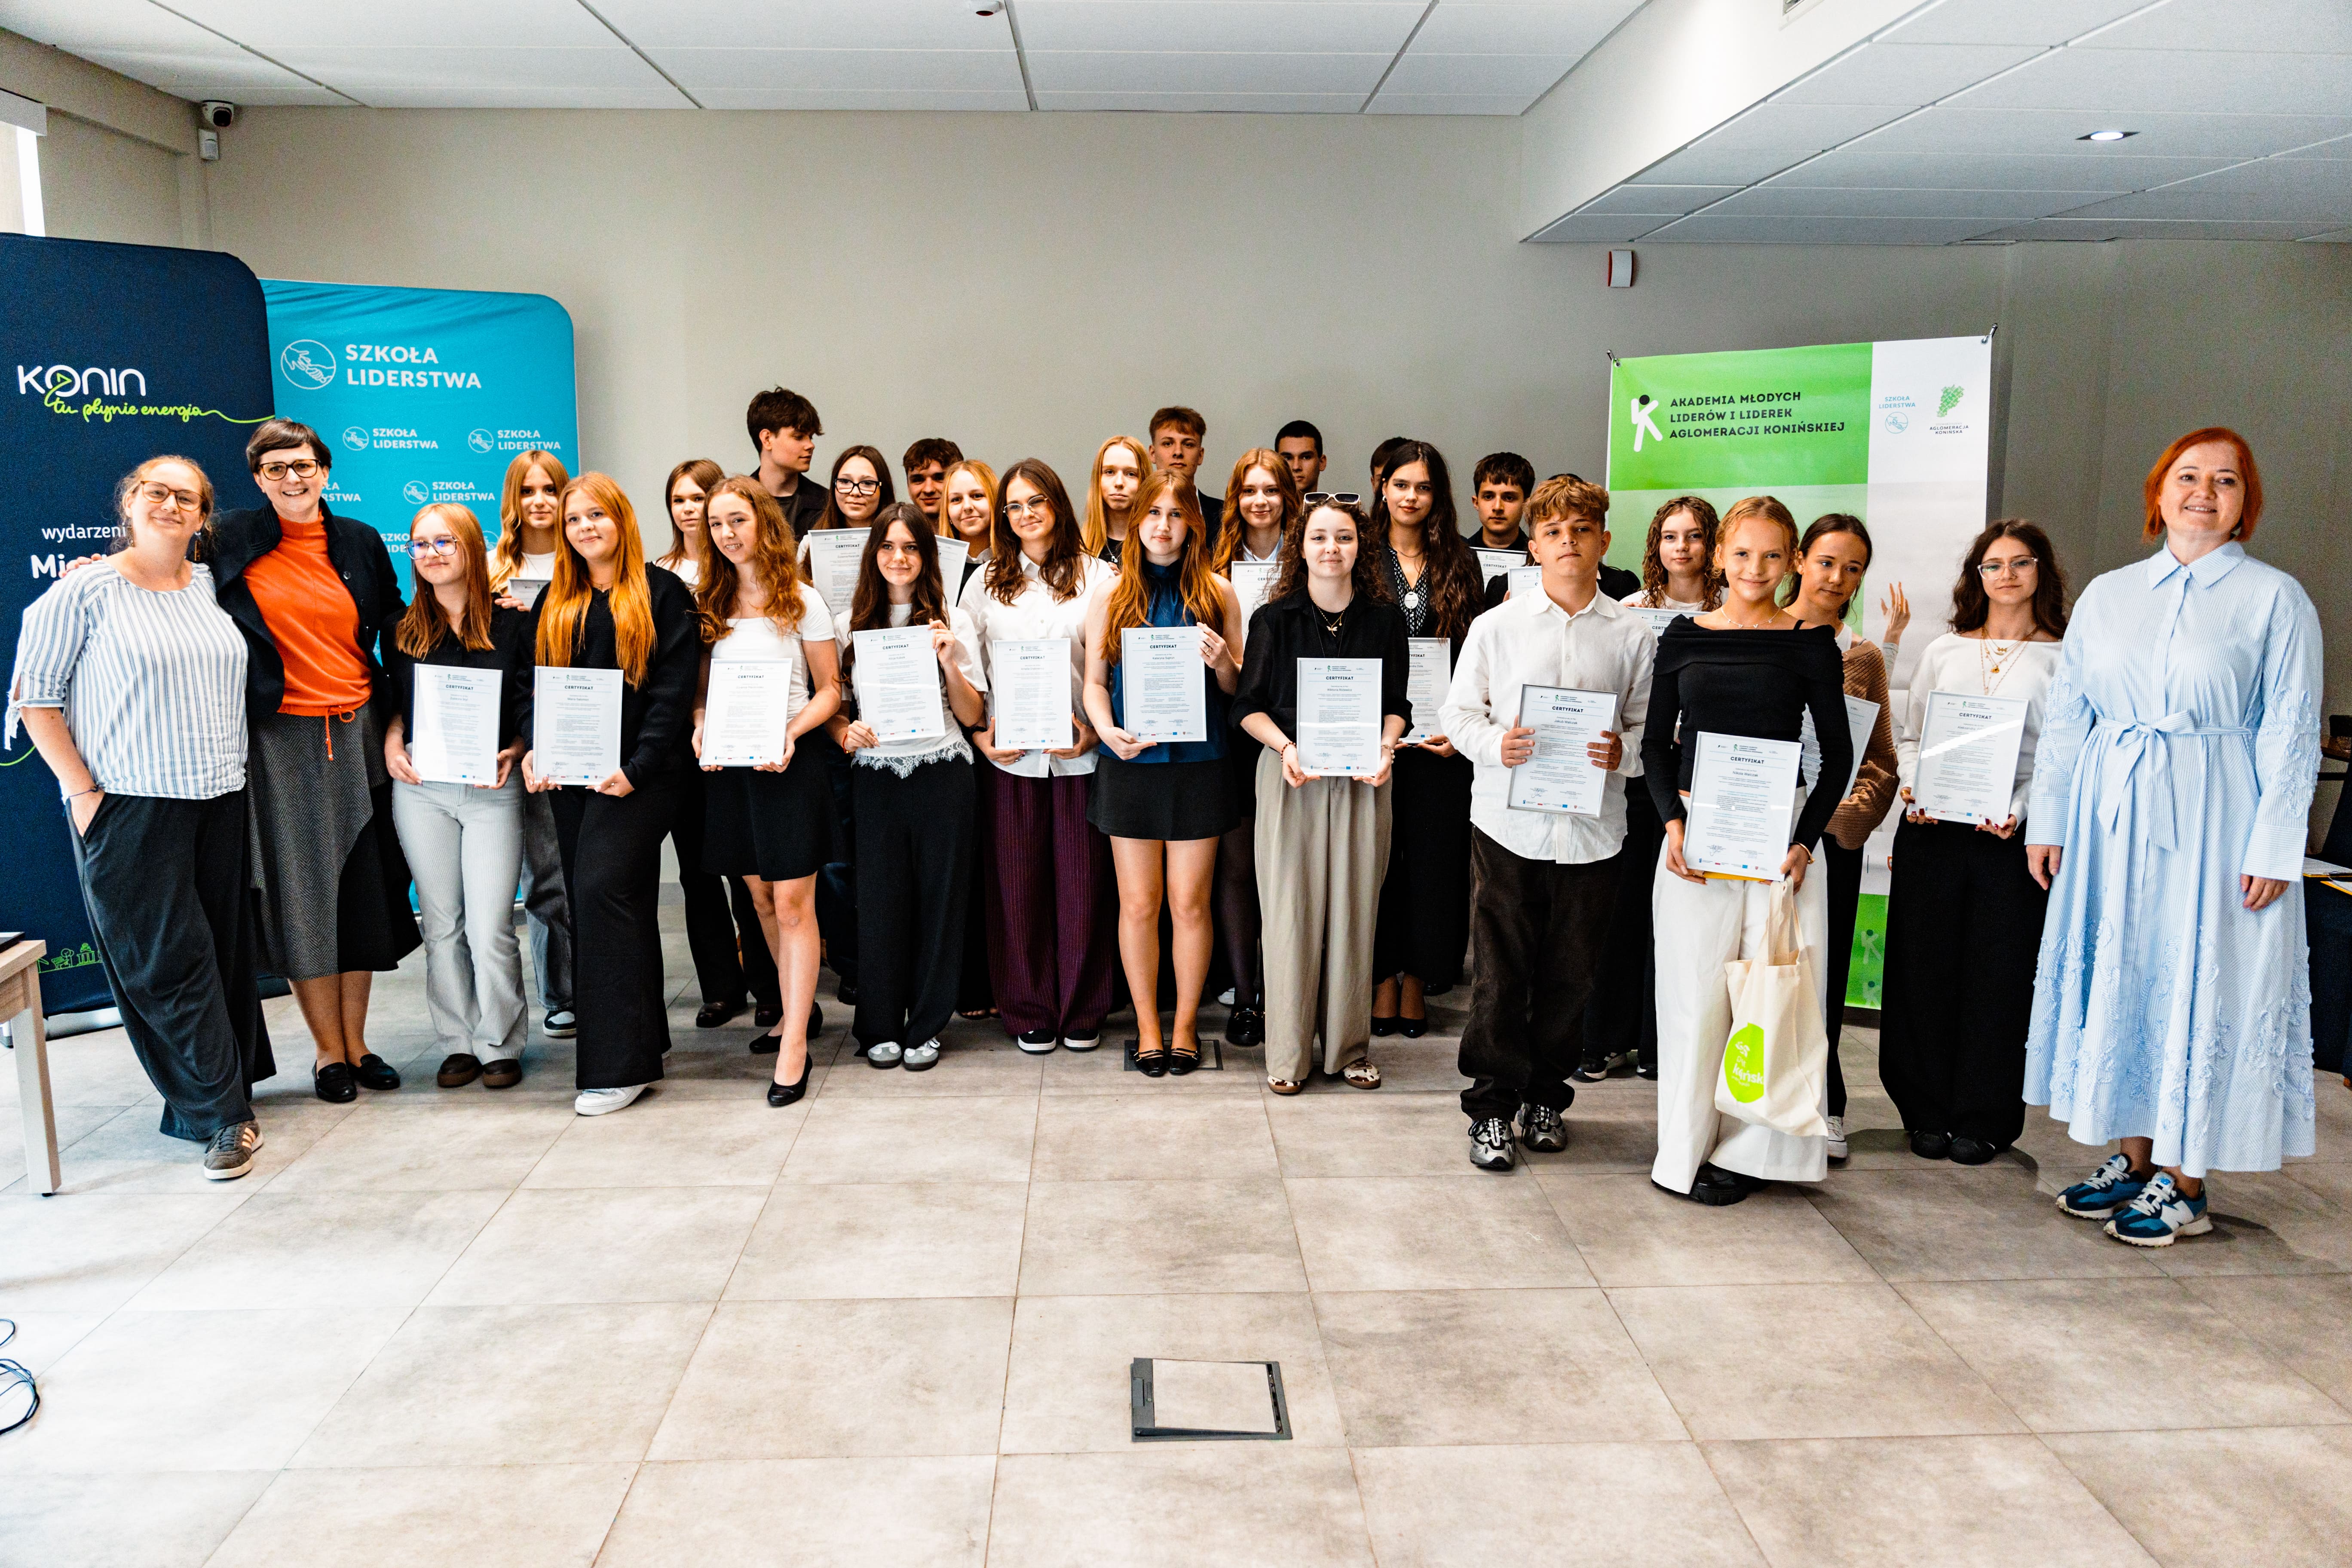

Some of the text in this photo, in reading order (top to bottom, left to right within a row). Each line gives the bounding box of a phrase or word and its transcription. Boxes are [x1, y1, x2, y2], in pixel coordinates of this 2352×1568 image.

[346, 344, 438, 364] SZKOŁA
[347, 369, 481, 389] LIDERSTWA
[1670, 392, 1801, 407] AKADEMIA MŁODYCH
[53, 397, 203, 423] tu płynie energia
[1670, 408, 1792, 423] LIDERÓW I LIDEREK
[373, 429, 417, 437] SZKOŁA
[498, 429, 541, 438] SZKOŁA
[1670, 421, 1845, 438] AGLOMERACJI KONIŃSKIEJ
[373, 440, 438, 449] LIDERSTWA
[498, 441, 560, 450] LIDERSTWA
[432, 481, 475, 490] SZKOŁA
[322, 493, 361, 502] RSTWA
[433, 492, 495, 501] LIDERSTWA
[42, 523, 126, 543] wydarzeni
[380, 533, 410, 542] SZKO
